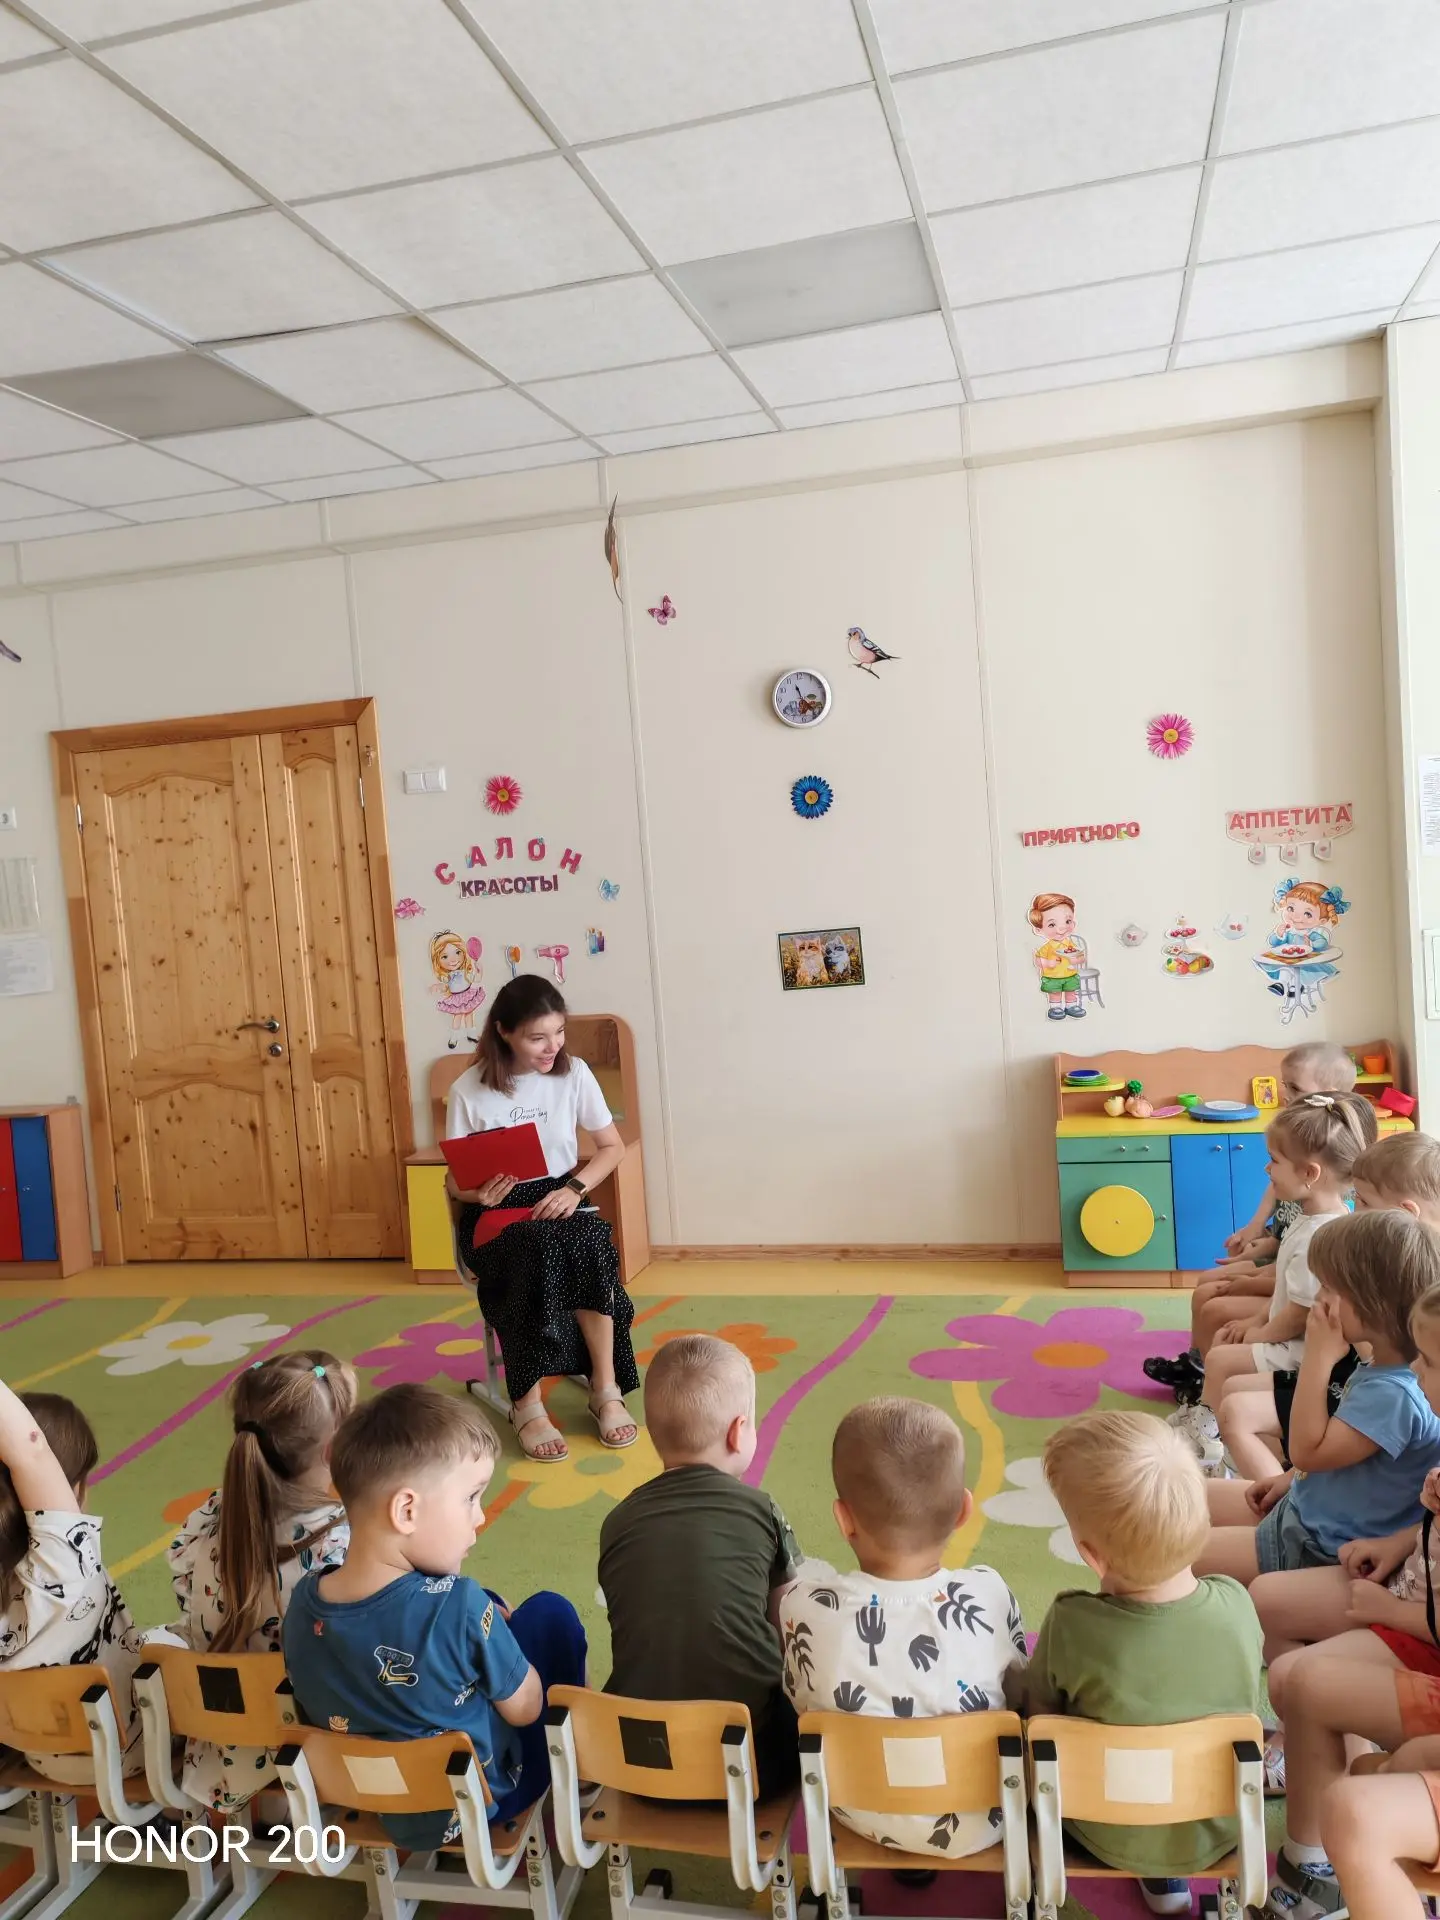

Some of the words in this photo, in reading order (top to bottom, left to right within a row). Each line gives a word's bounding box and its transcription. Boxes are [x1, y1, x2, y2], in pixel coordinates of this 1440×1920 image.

[1230, 806, 1351, 830] АППЕТИТА
[1024, 822, 1140, 847] ПРИЯТНОГО
[434, 837, 582, 886] САЛОН
[460, 874, 559, 898] КРАСОТЫ
